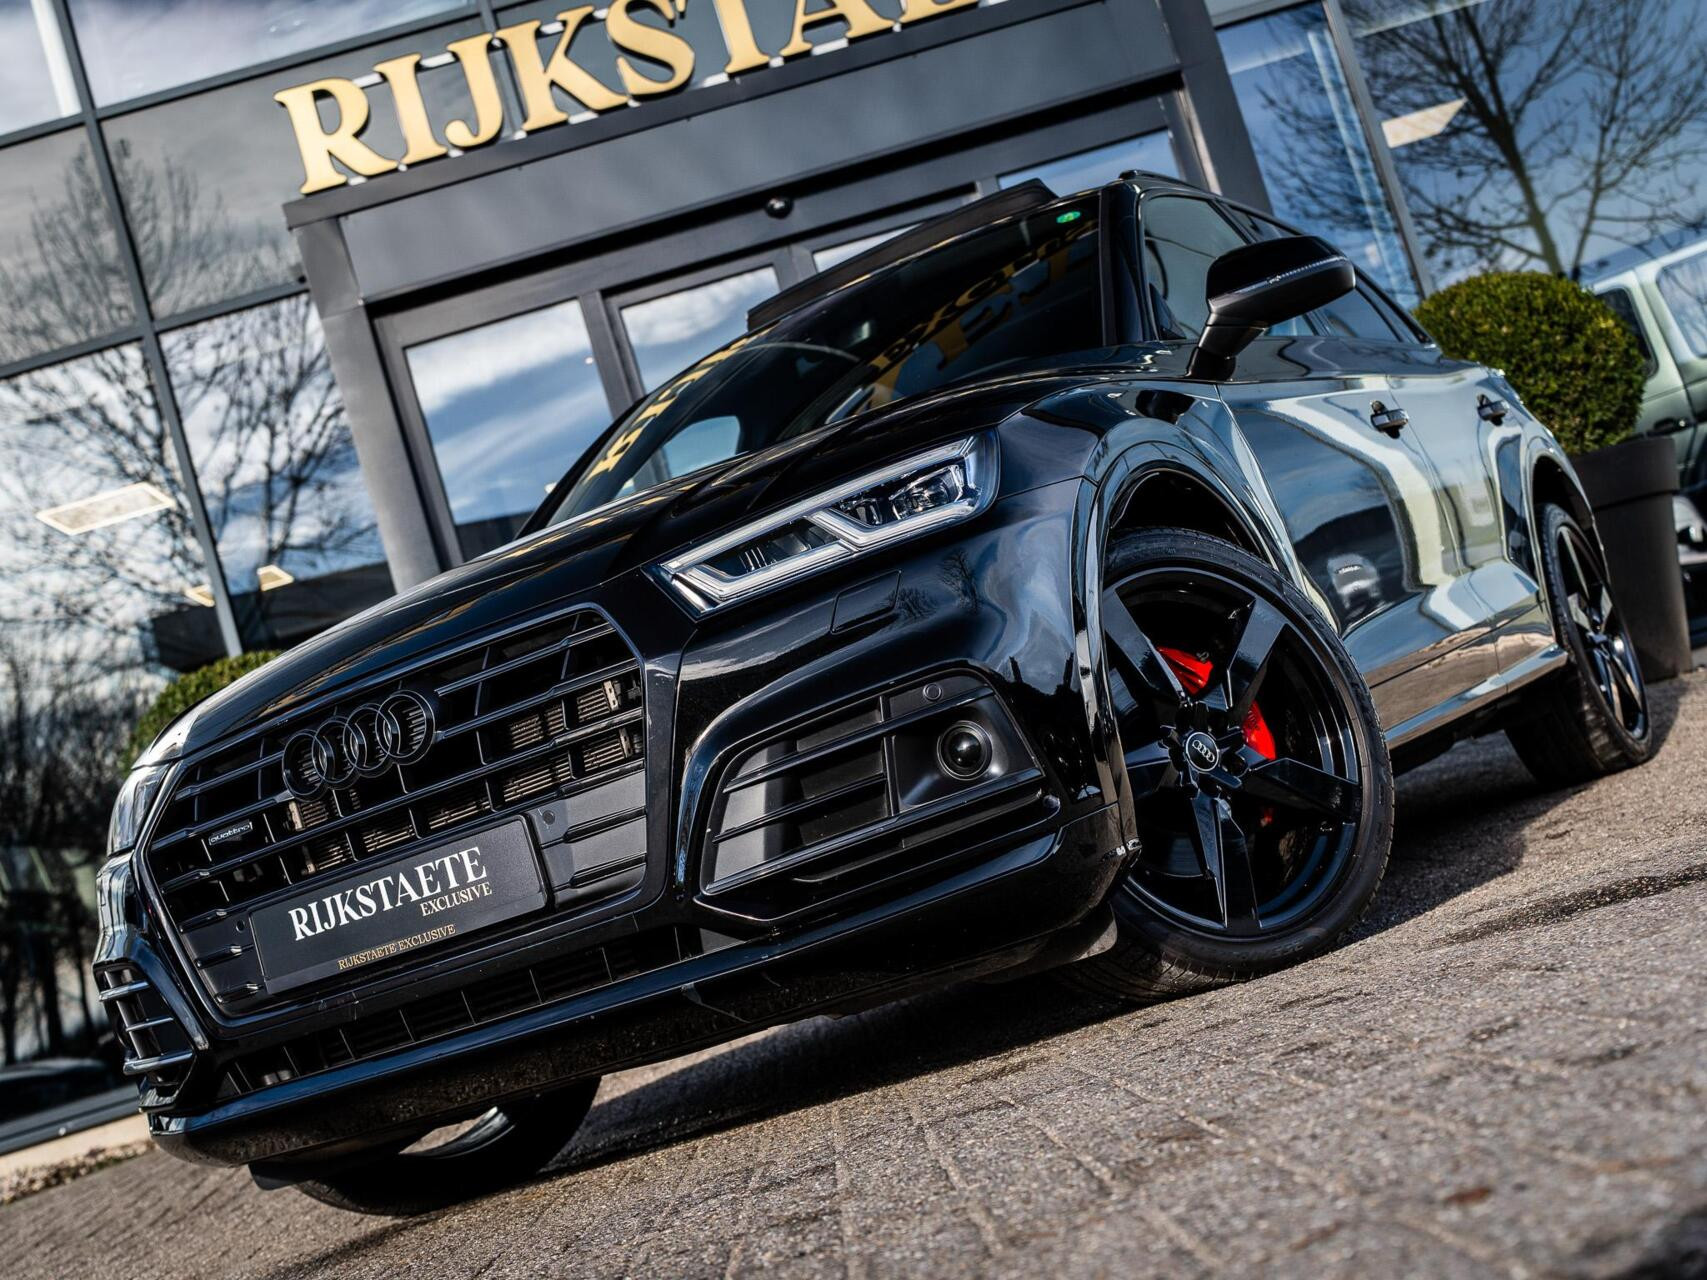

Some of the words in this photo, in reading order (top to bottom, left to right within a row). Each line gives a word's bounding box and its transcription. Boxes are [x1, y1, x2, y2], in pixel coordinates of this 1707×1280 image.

[209, 822, 252, 845] quattro
[288, 846, 488, 941] RIJKSTAETE
[419, 881, 493, 917] EXCLUSIVE
[337, 942, 397, 970] RIJKSTAETE
[398, 923, 456, 951] EXCLUSIVE
